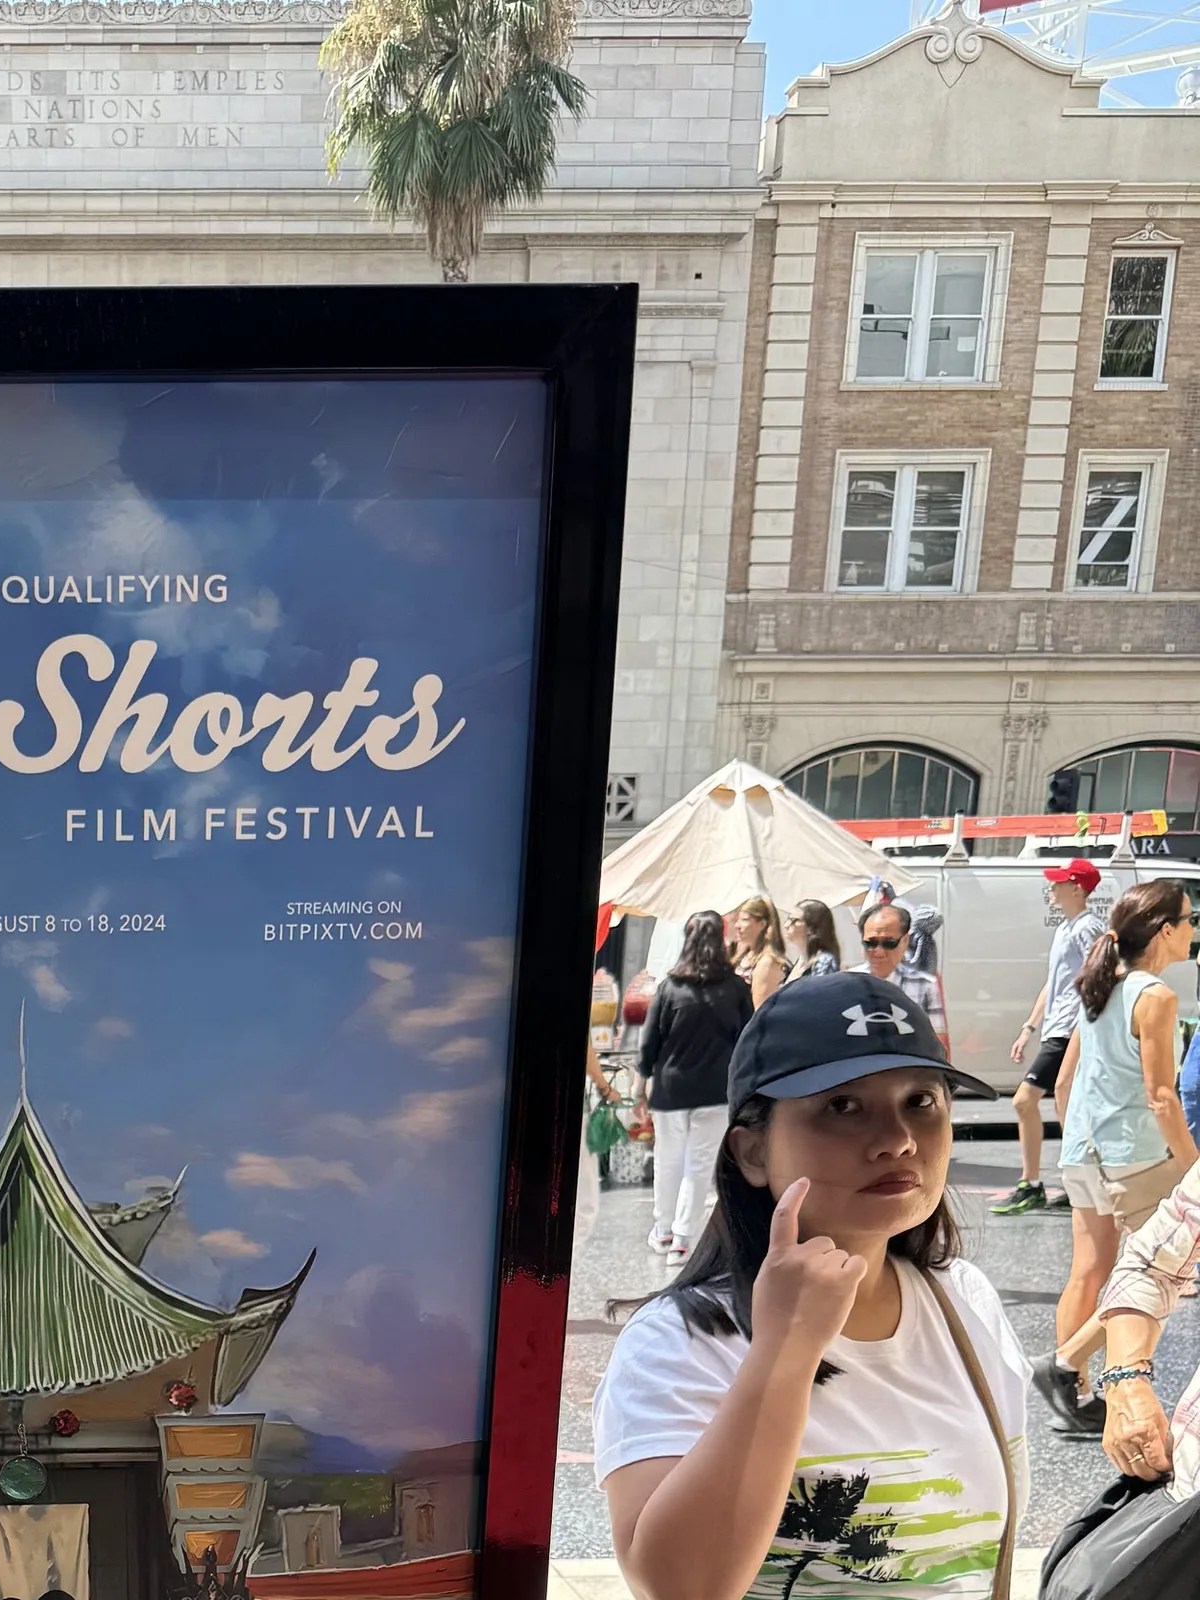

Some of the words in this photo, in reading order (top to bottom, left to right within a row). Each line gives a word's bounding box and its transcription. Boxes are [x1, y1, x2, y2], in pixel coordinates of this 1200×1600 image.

[76, 71, 121, 91] ITS
[152, 70, 286, 91] TEMPLES
[23, 99, 162, 119] NATIONS
[111, 127, 146, 147] OF
[182, 127, 245, 147] MEN
[66, 808, 178, 843] FILM
[204, 806, 436, 842] FESTIVAL
[286, 901, 373, 916] STREAMING
[377, 900, 402, 915] ON
[44, 915, 56, 933] 8
[86, 914, 115, 935] 18,
[119, 913, 167, 933] 2024
[263, 921, 423, 942] BITPIXTV.COM
